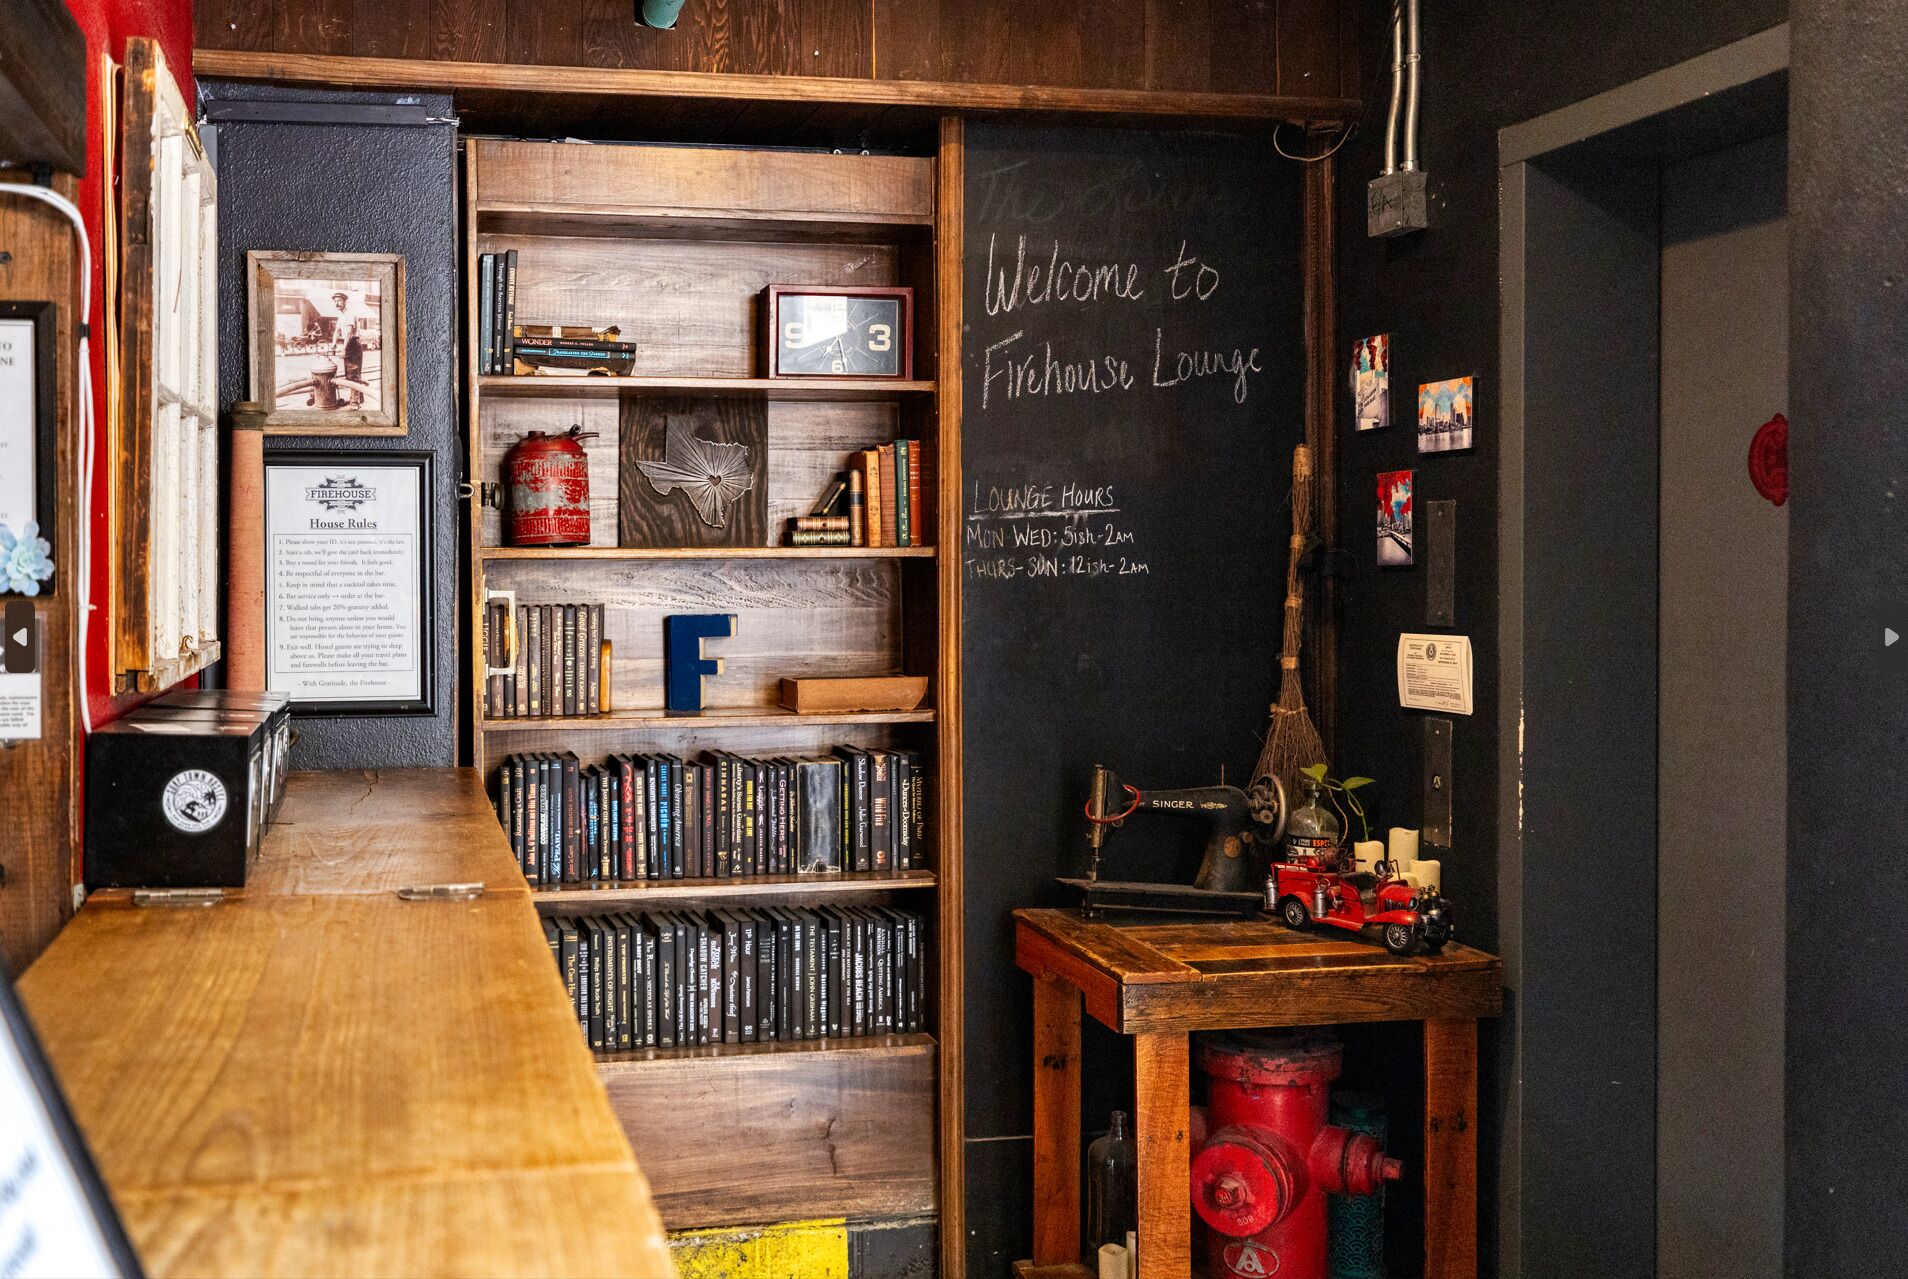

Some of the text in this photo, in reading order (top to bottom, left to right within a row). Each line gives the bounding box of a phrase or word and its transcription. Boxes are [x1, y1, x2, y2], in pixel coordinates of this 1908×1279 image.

[986, 232, 1220, 316] Welcome to
[784, 322, 804, 349] 9
[868, 324, 891, 352] 3
[831, 360, 844, 373] 6
[982, 328, 1263, 409] Firehouse Lounge
[311, 490, 372, 499] FIREHOUSE
[974, 480, 1114, 512] LOUNGE HOURS
[310, 519, 378, 528] House Rules
[966, 523, 1004, 548] MON
[1013, 522, 1058, 548] WED:
[664, 614, 738, 709] F
[184, 771, 207, 782] TOWN
[528, 784, 536, 798] Times
[672, 784, 682, 816] Observing
[858, 758, 866, 848] Shadow Dance Julie Garwood
[1152, 800, 1194, 808] SINGER
[514, 809, 523, 836] Recasting
[528, 810, 536, 819] and
[874, 798, 887, 826] Wild Fire
[528, 820, 536, 846] O'Sullivan
[528, 853, 536, 866] John
[607, 982, 614, 990] OF
